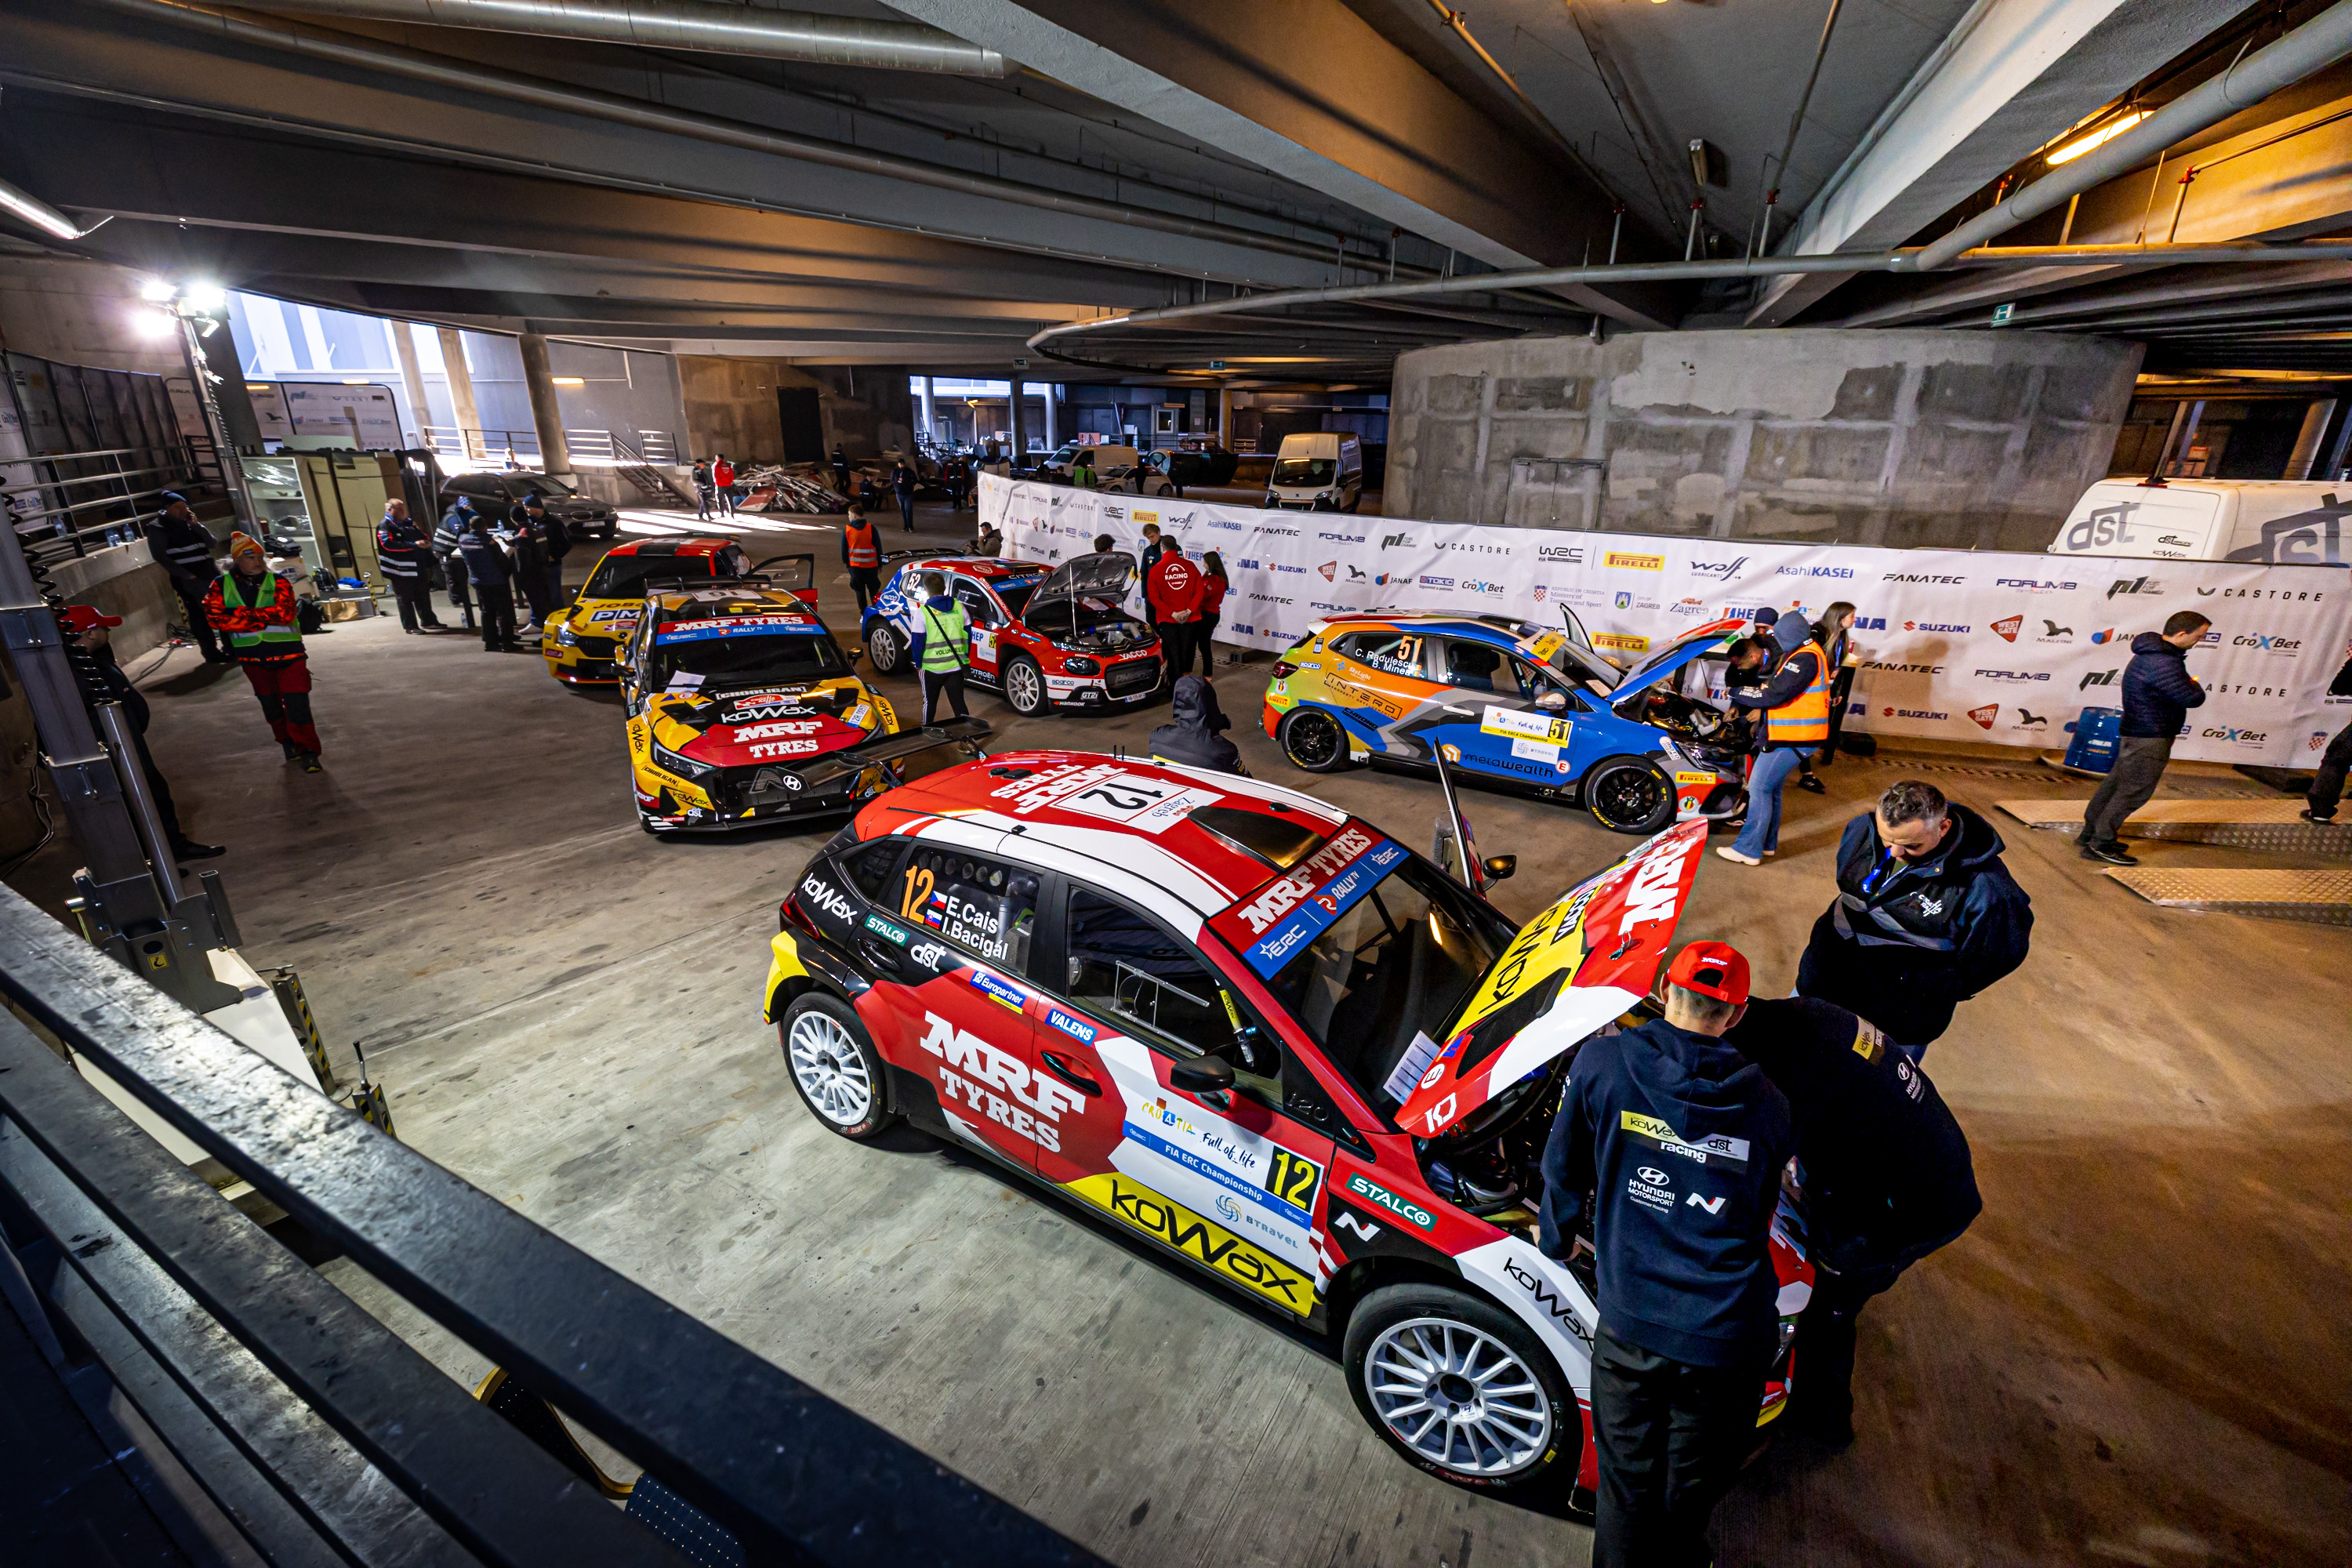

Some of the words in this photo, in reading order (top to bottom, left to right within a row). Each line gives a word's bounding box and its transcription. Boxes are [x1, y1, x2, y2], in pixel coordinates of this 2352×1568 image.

[1134, 510, 1156, 522] PIRELLI
[1207, 520, 1242, 531] AsahiKASEI
[1254, 527, 1301, 536] FANATEC
[2067, 502, 2141, 550] dst
[1319, 532, 1366, 543] FORUM8
[1451, 543, 1511, 555] CASTORE
[1539, 546, 1584, 557] WRC
[1236, 558, 1259, 570] INA
[1277, 564, 1307, 574] SUZUKI
[1608, 554, 1660, 569] PIRELLI
[1165, 572, 1188, 581] RACING
[1775, 565, 1854, 579] AsahiKASEI
[1882, 573, 1965, 584] FANATEC
[907, 573, 921, 591] 52
[1427, 577, 1454, 586] TOKIC
[1461, 579, 1504, 593] CroXBet
[1996, 579, 2078, 590] FORUM8
[1248, 593, 1294, 604] FANATEC
[1550, 591, 1574, 600] Ministry
[2224, 588, 2323, 601] CASTORE
[1736, 608, 1755, 619] HE
[673, 619, 736, 632] MRF
[739, 616, 804, 626] TYRES
[1232, 622, 1254, 635] INA
[1854, 617, 1886, 630] NA
[1918, 623, 1970, 633] SUZUKI
[1398, 635, 1423, 660] 51
[1595, 635, 1644, 650] PIRELLI
[2233, 632, 2302, 650] CroXBet
[935, 647, 964, 655] VOLUNEER
[1120, 649, 1147, 661] YACCO
[1356, 648, 1364, 657] C.
[1348, 666, 1371, 681] SkyLight
[1372, 661, 1380, 670] B.
[1382, 662, 1411, 677] Minea
[1862, 661, 1944, 674] FANATEC
[1975, 670, 2051, 681] FORUM8
[1330, 677, 1396, 714] INTERO
[2205, 682, 2287, 697] ASTORE
[1343, 706, 1379, 729] CHRONO
[1897, 709, 1948, 720] SUZUKI
[734, 721, 822, 743] MRF
[1519, 732, 1548, 743] Championship
[1549, 720, 1571, 741] 51
[2201, 725, 2267, 742] CroXBet
[750, 740, 818, 758] TYRES
[990, 764, 1086, 798] TYRES
[1679, 773, 1713, 782] PIRELLI
[1013, 763, 1128, 815] MRF
[1080, 782, 1164, 811] 12
[1152, 797, 1196, 818] Zagreb
[1237, 864, 1316, 935] MRF
[1308, 828, 1372, 877] TYRES
[1331, 877, 1357, 901] RALLY
[1617, 836, 1699, 936] MRF
[901, 865, 935, 924] 12
[946, 895, 998, 935] E.Cais
[1555, 888, 1596, 942] YACCO
[866, 916, 906, 943] STALCO
[942, 916, 1009, 960] I.Bacigál
[910, 942, 946, 973] dst
[1701, 956, 1728, 966] MRF
[981, 977, 1024, 1004] Europartner
[1050, 1011, 1094, 1042] VALENS
[920, 1010, 1087, 1123] MRF
[939, 1066, 1062, 1153] TYRES
[1142, 1102, 1195, 1134] CROATIA
[1200, 1132, 1221, 1152] Full
[1239, 1151, 1256, 1170] life
[1660, 1142, 1708, 1163] racing
[1708, 1138, 1733, 1152] dst
[1165, 1145, 1179, 1160] FIA
[1181, 1152, 1199, 1168] ERC
[1201, 1163, 1263, 1202] Championship
[1272, 1152, 1316, 1210] 12
[1628, 1178, 1675, 1201] HYUNDAI
[1628, 1186, 1675, 1207] MOTORSPORT
[1351, 1177, 1431, 1225] STALCO
[1630, 1196, 1652, 1208] Customer
[1652, 1203, 1670, 1214] Racing
